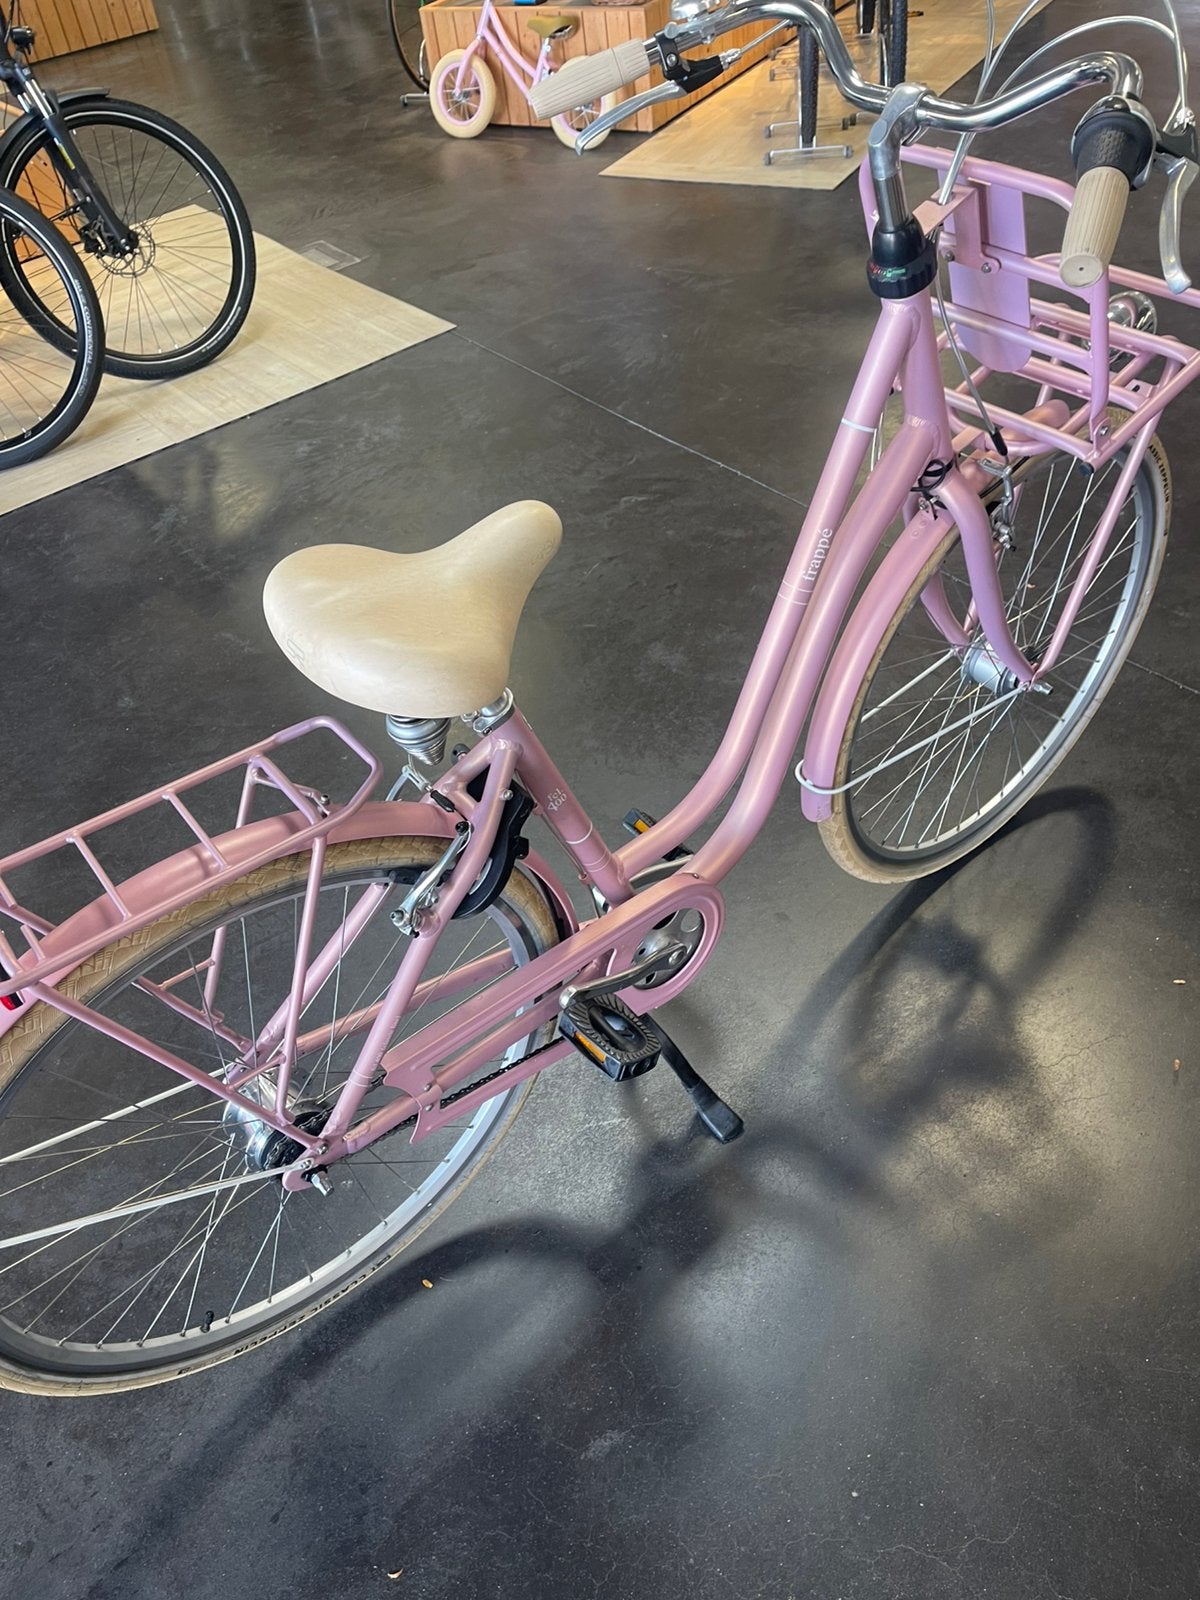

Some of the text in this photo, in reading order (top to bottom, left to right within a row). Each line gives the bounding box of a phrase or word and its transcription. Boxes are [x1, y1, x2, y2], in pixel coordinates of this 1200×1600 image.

[1158, 463, 1170, 502] ZEPPELIN
[801, 528, 833, 581] frappé
[547, 793, 567, 811] 400
[233, 1273, 367, 1355] CLASSIC ZEPPELIN
